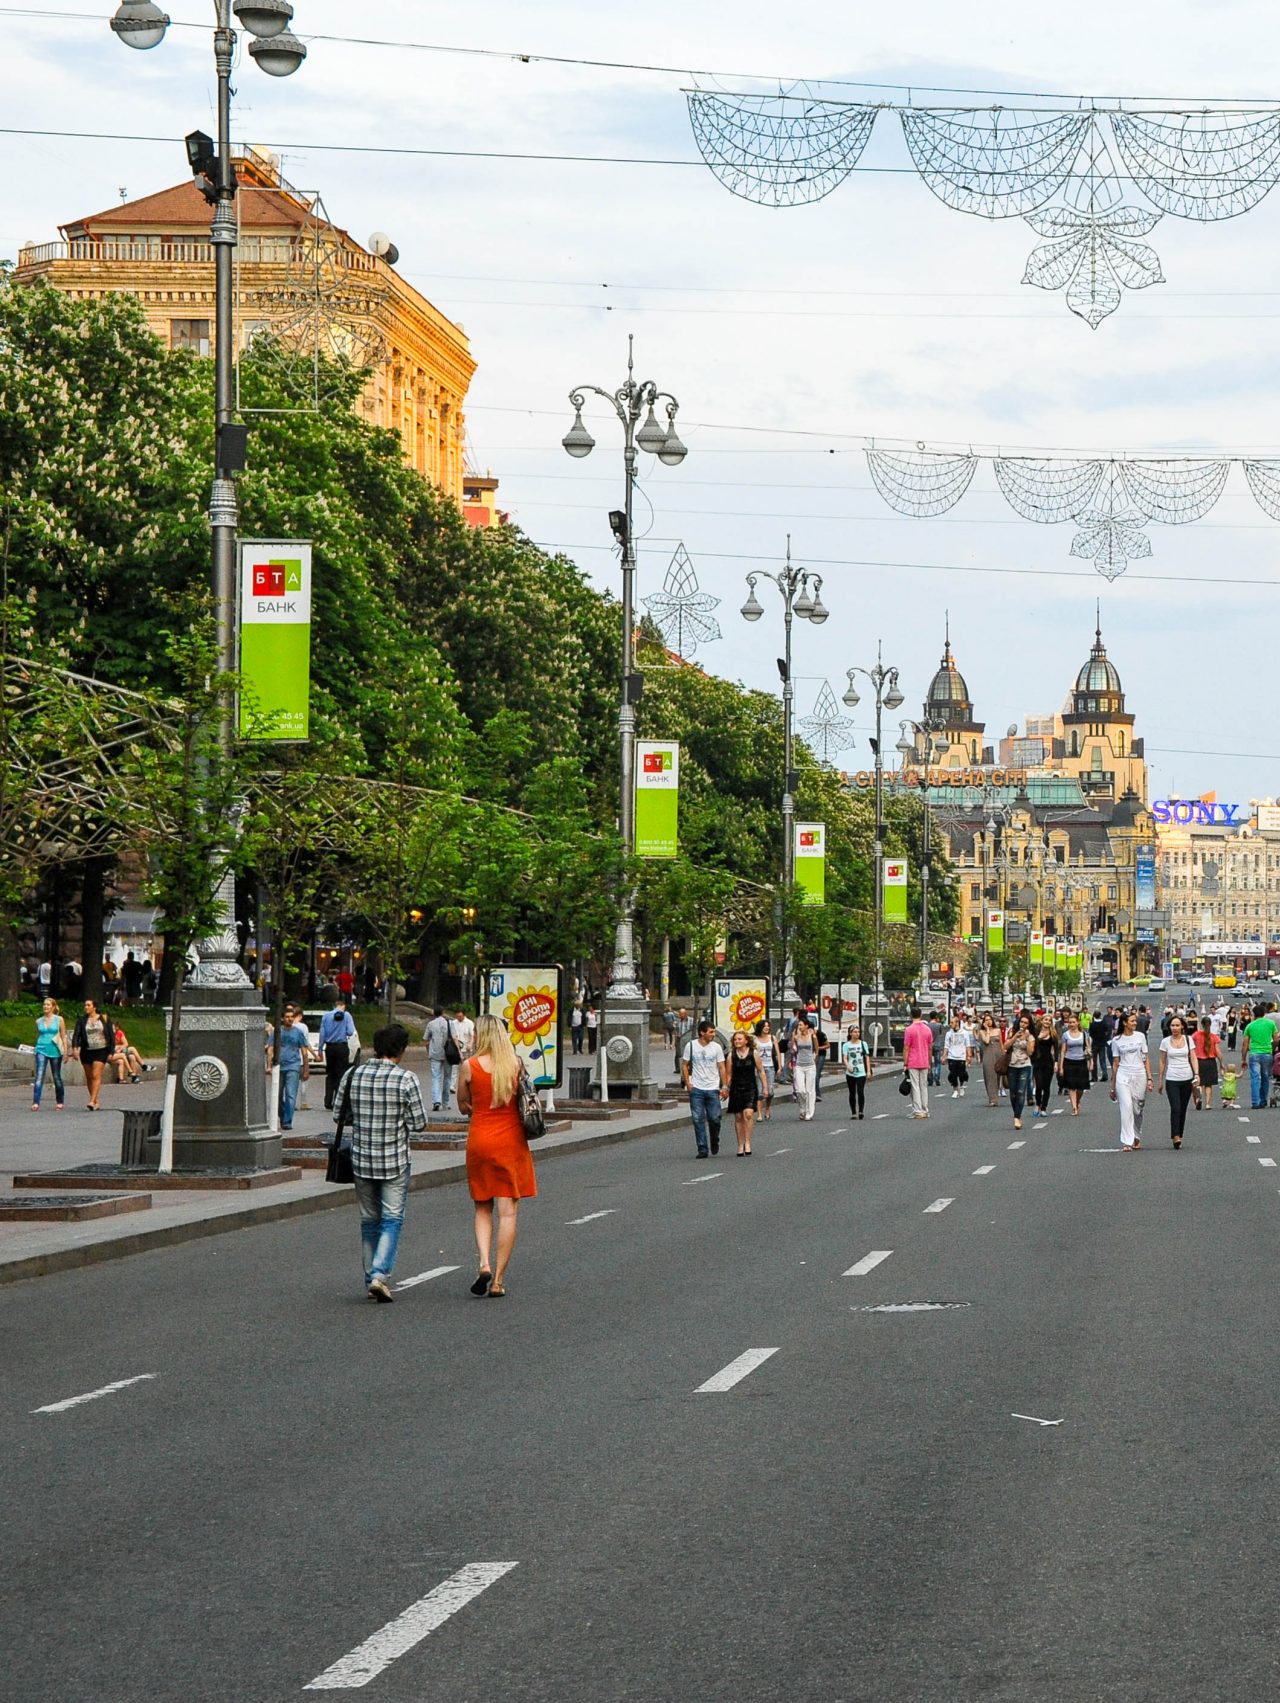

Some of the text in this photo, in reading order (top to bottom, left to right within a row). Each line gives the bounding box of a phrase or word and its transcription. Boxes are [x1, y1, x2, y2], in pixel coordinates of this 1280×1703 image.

[256, 572, 299, 584] БТА
[257, 602, 296, 613] БАНК
[645, 758, 671, 766] БТА
[927, 771, 986, 786] АРЕНА
[1152, 799, 1240, 826] SONY
[519, 996, 537, 1012] ДНІ
